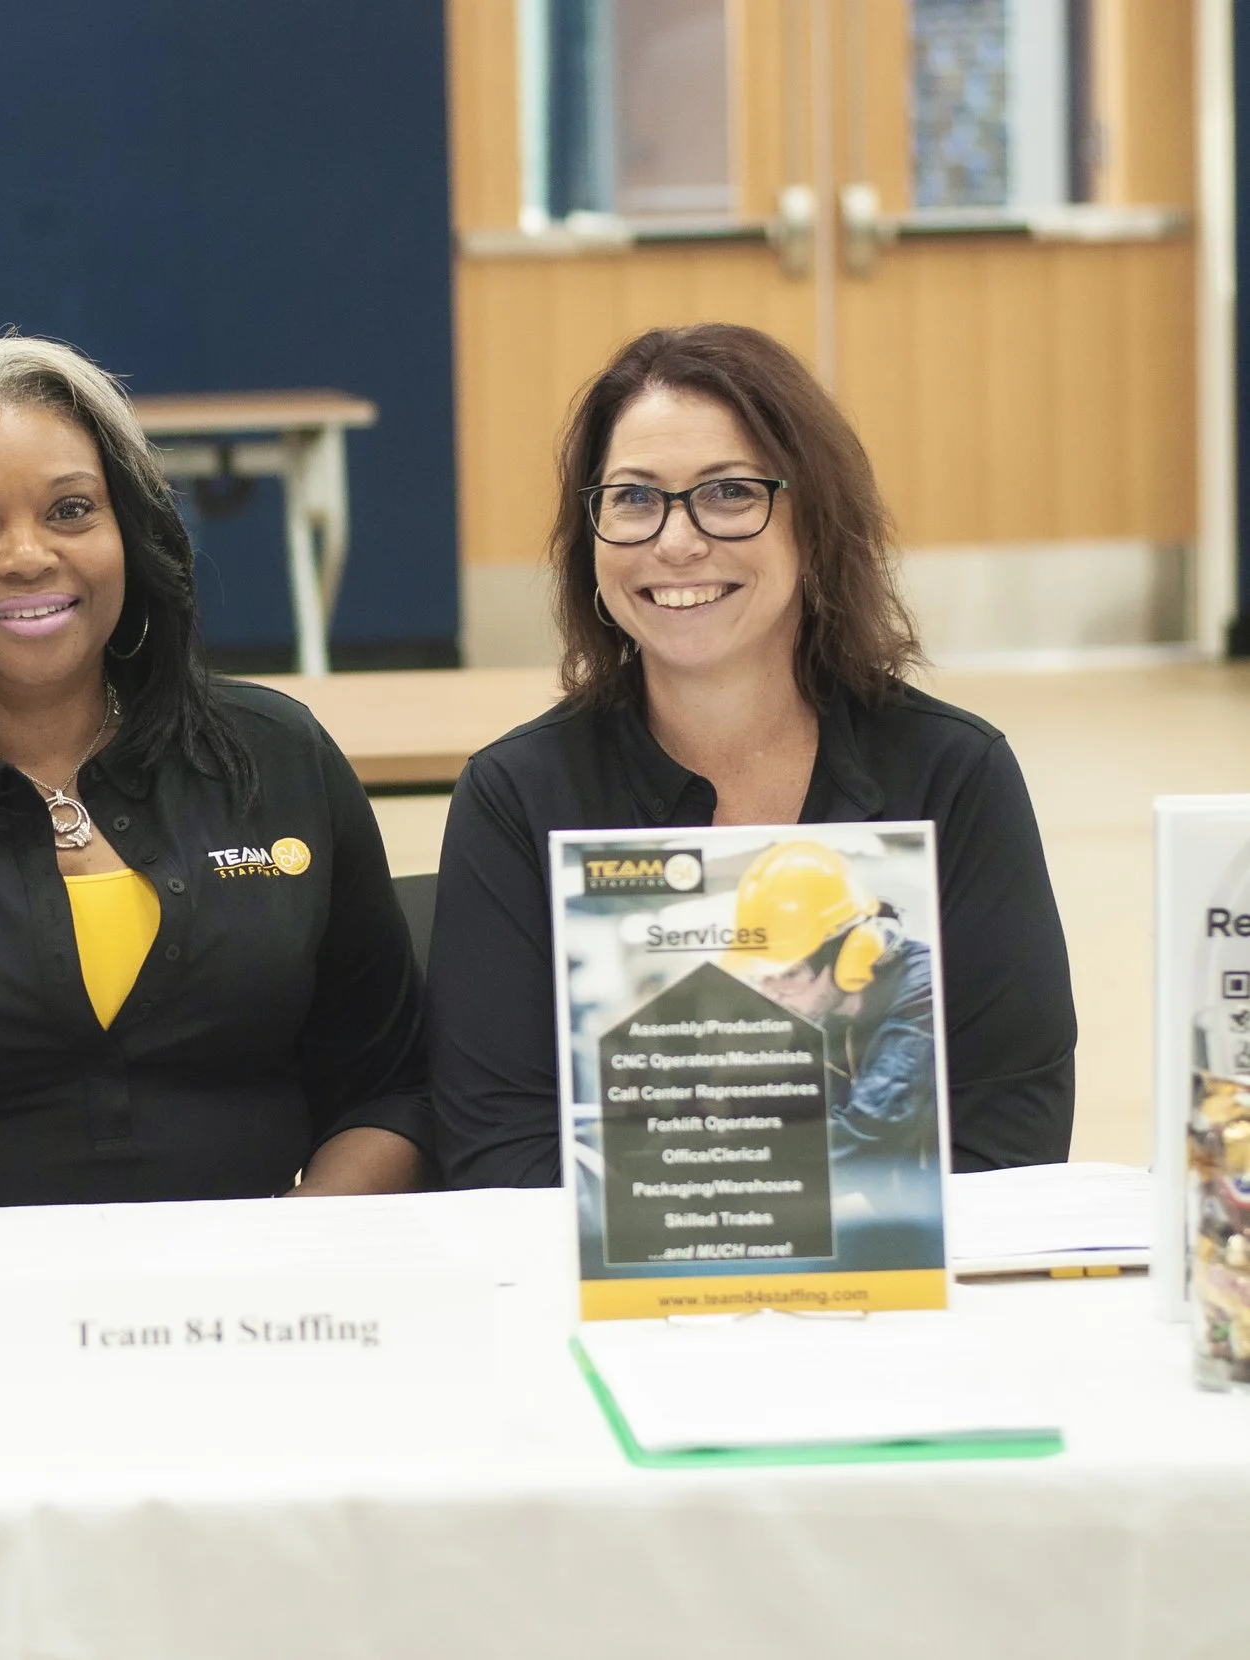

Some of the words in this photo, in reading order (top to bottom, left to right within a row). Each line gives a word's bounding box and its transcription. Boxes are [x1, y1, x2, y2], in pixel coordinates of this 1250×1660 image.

[207, 846, 274, 868] TEAM
[277, 843, 305, 868] 84
[586, 859, 665, 877] TEAM
[646, 923, 768, 948] Services
[628, 1019, 793, 1038] Assembly/Production
[610, 1053, 649, 1070] CNC
[607, 1086, 640, 1102] Call
[640, 1085, 694, 1101] Center
[694, 1082, 820, 1100] Representatives
[647, 1116, 704, 1132] Forklift
[704, 1115, 783, 1133] Operators
[662, 1147, 772, 1165] Office/Clerical
[632, 1178, 804, 1200] Packaging/Warehouse
[664, 1213, 717, 1228] Skilled
[720, 1210, 774, 1227] Trades
[695, 1243, 746, 1259] MUCH
[747, 1241, 794, 1257] more!
[70, 1318, 172, 1348] Team
[184, 1317, 223, 1343] 84
[238, 1313, 381, 1348] Staffing
